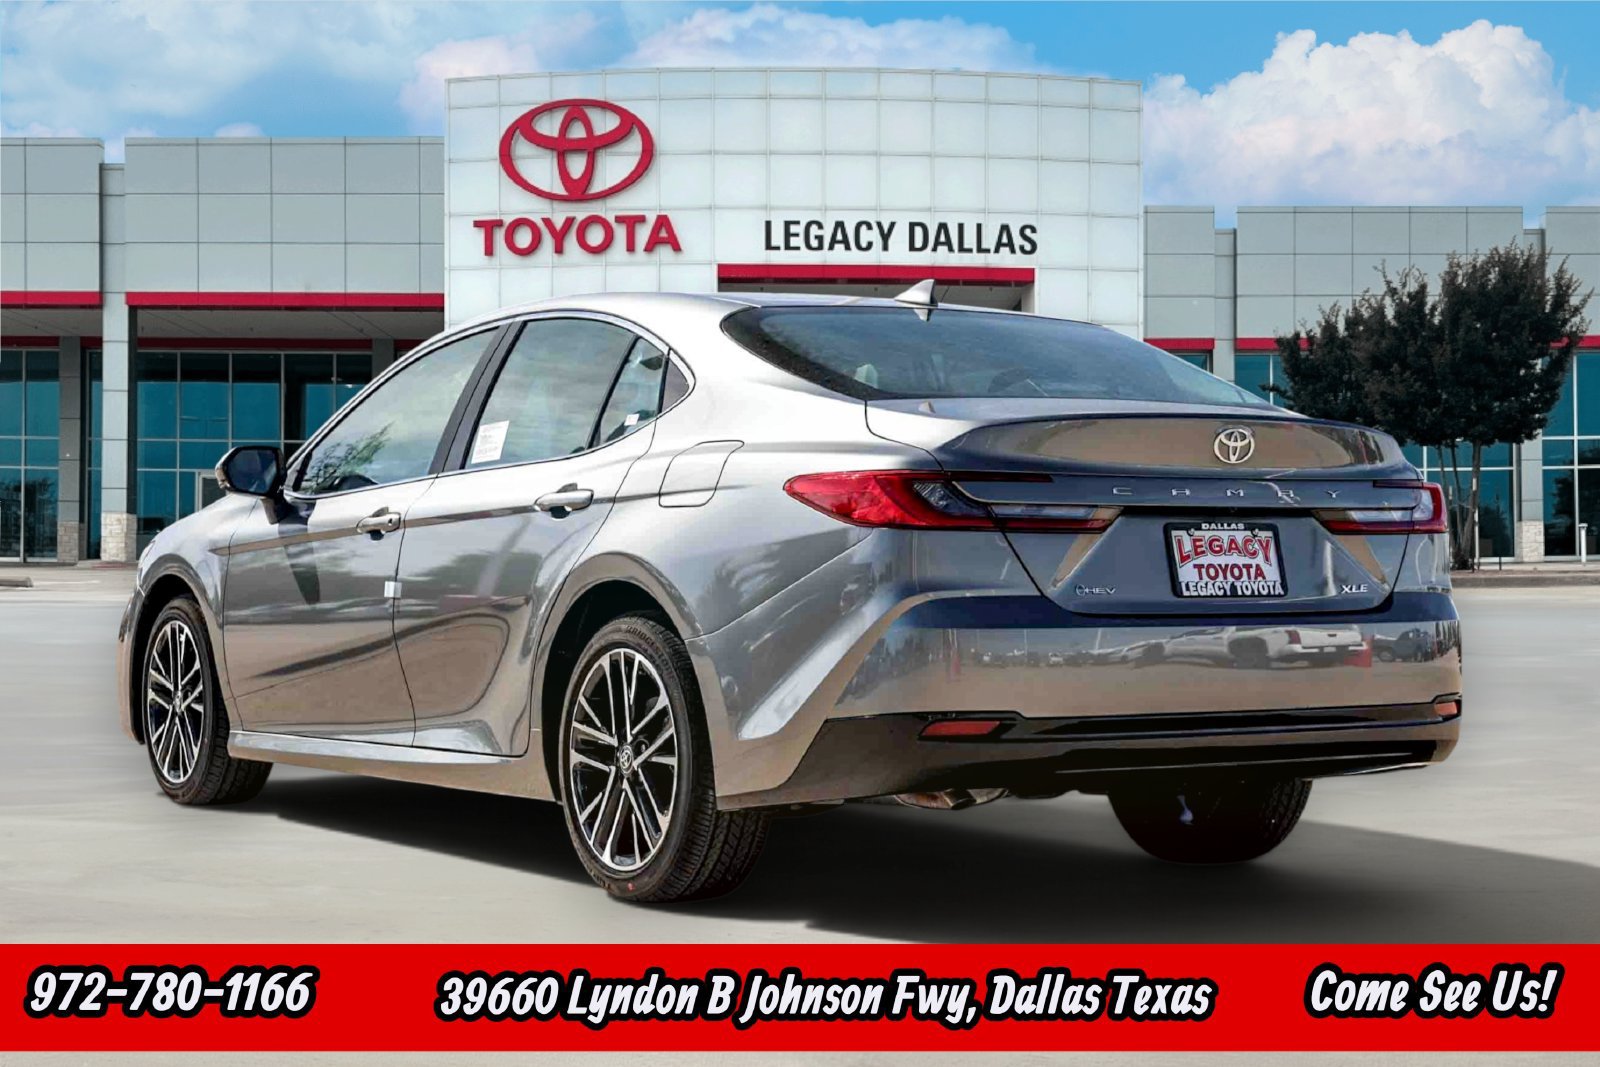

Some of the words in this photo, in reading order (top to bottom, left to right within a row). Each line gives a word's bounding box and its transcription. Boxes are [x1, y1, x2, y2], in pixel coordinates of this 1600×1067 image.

[474, 214, 681, 257] TOYOTA
[764, 220, 897, 252] LEGACY
[908, 221, 1038, 256] DALLAS
[1112, 486, 1341, 499] CAMRY
[1174, 534, 1272, 567] LEGACY
[1193, 563, 1266, 581] TOYOTA
[1181, 581, 1231, 596] LEGACY
[1234, 580, 1285, 595] TOYOTA
[1341, 583, 1369, 594] XLE
